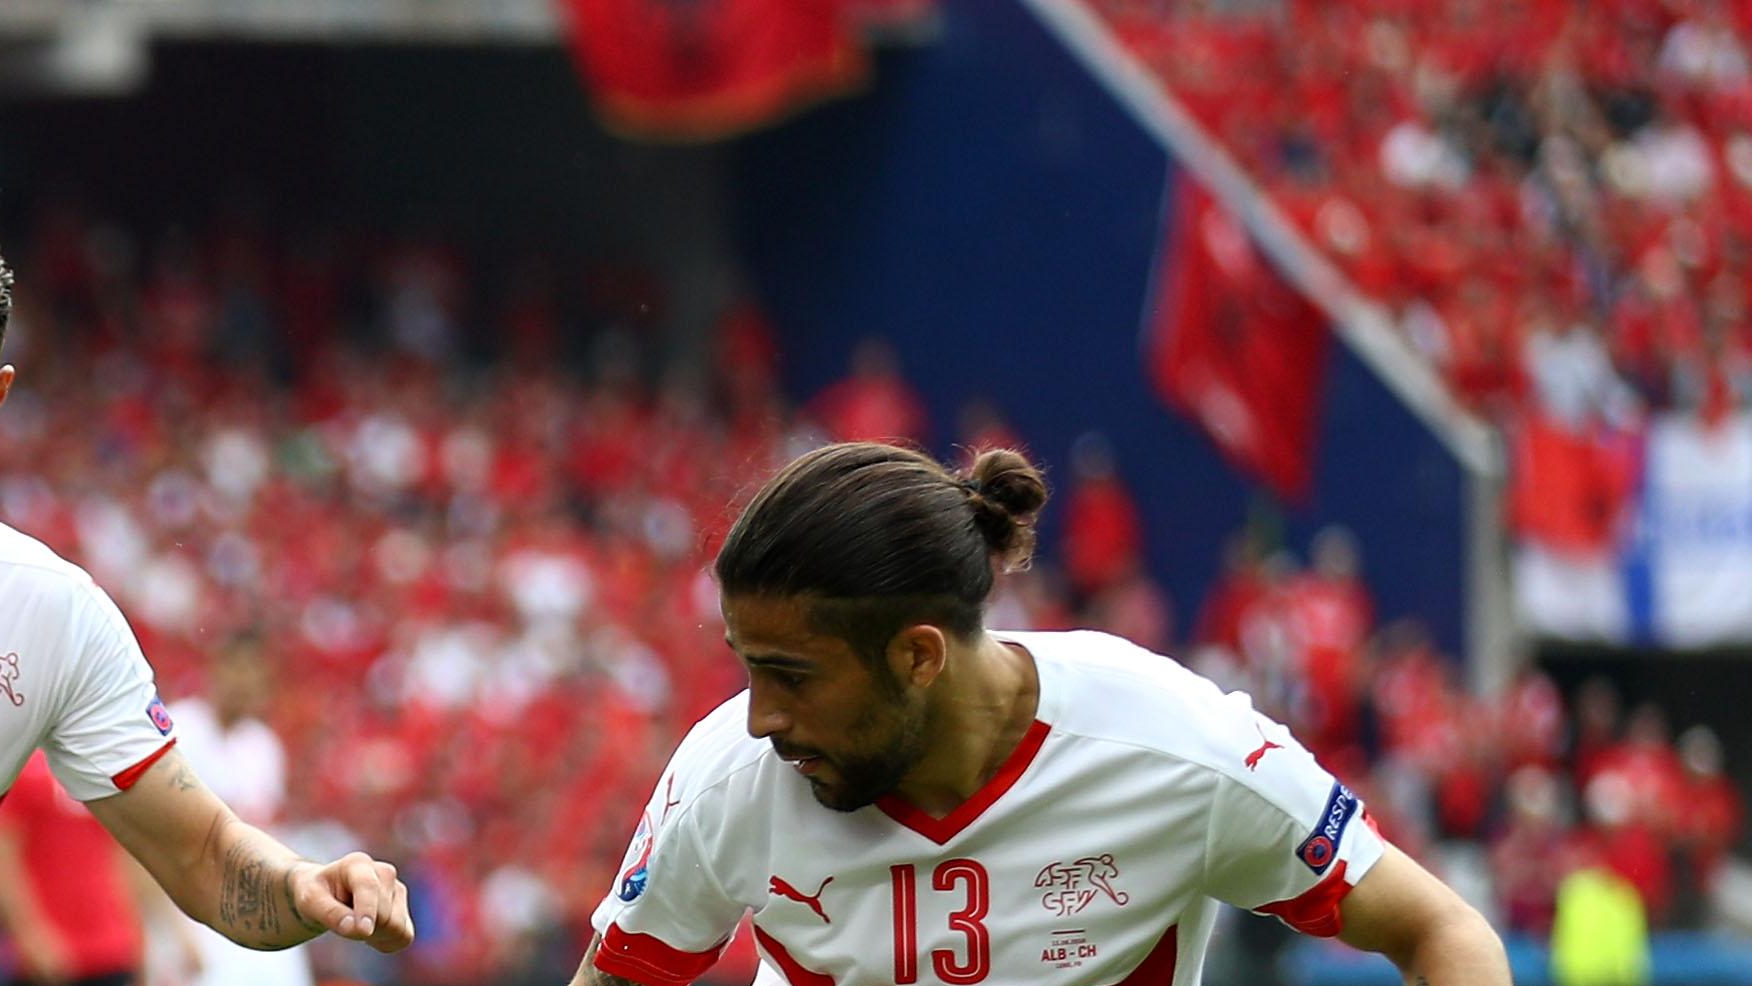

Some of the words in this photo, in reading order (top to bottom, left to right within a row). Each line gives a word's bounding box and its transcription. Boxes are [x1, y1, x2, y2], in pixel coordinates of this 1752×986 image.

[888, 858, 991, 986] 13
[1040, 947, 1067, 962] ALB
[1078, 944, 1097, 958] CH
